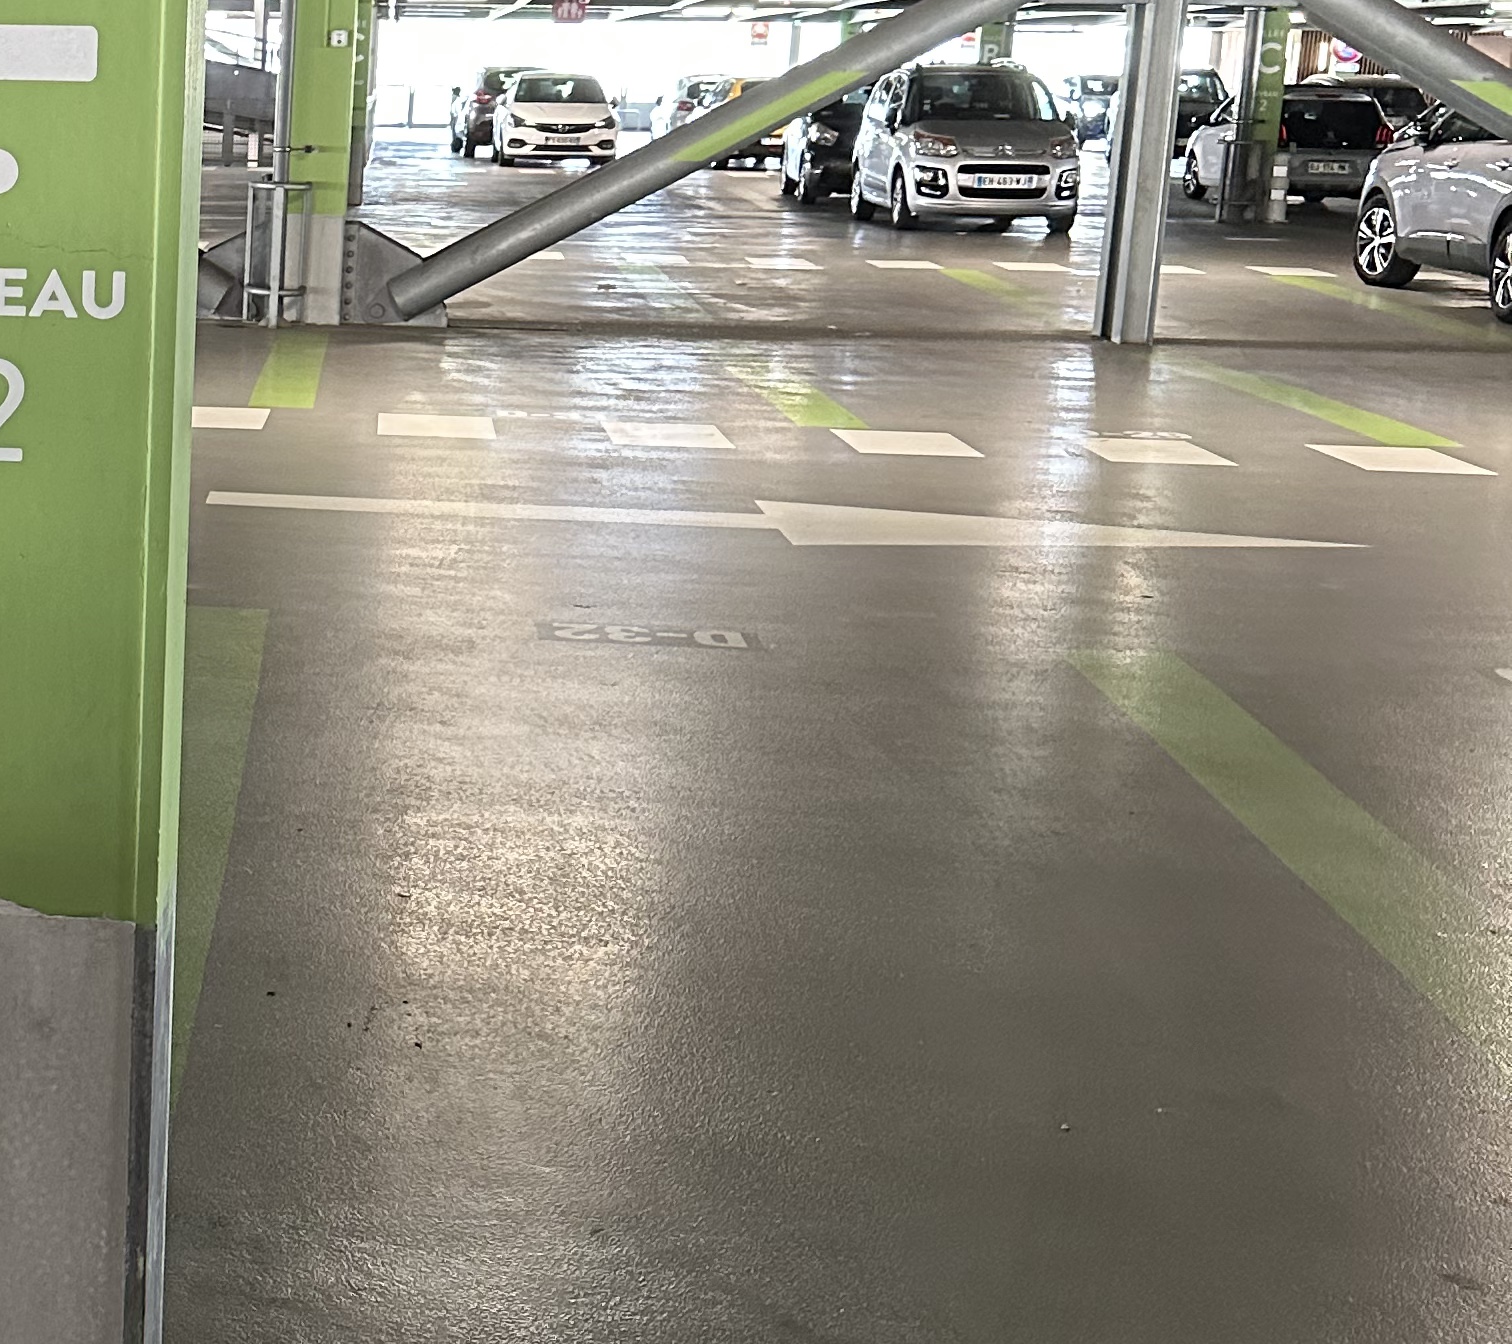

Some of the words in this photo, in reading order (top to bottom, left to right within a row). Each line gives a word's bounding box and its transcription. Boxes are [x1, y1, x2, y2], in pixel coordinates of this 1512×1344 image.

[1259, 42, 1283, 74] C
[1259, 99, 1268, 111] 2
[551, 622, 749, 648] D-32
